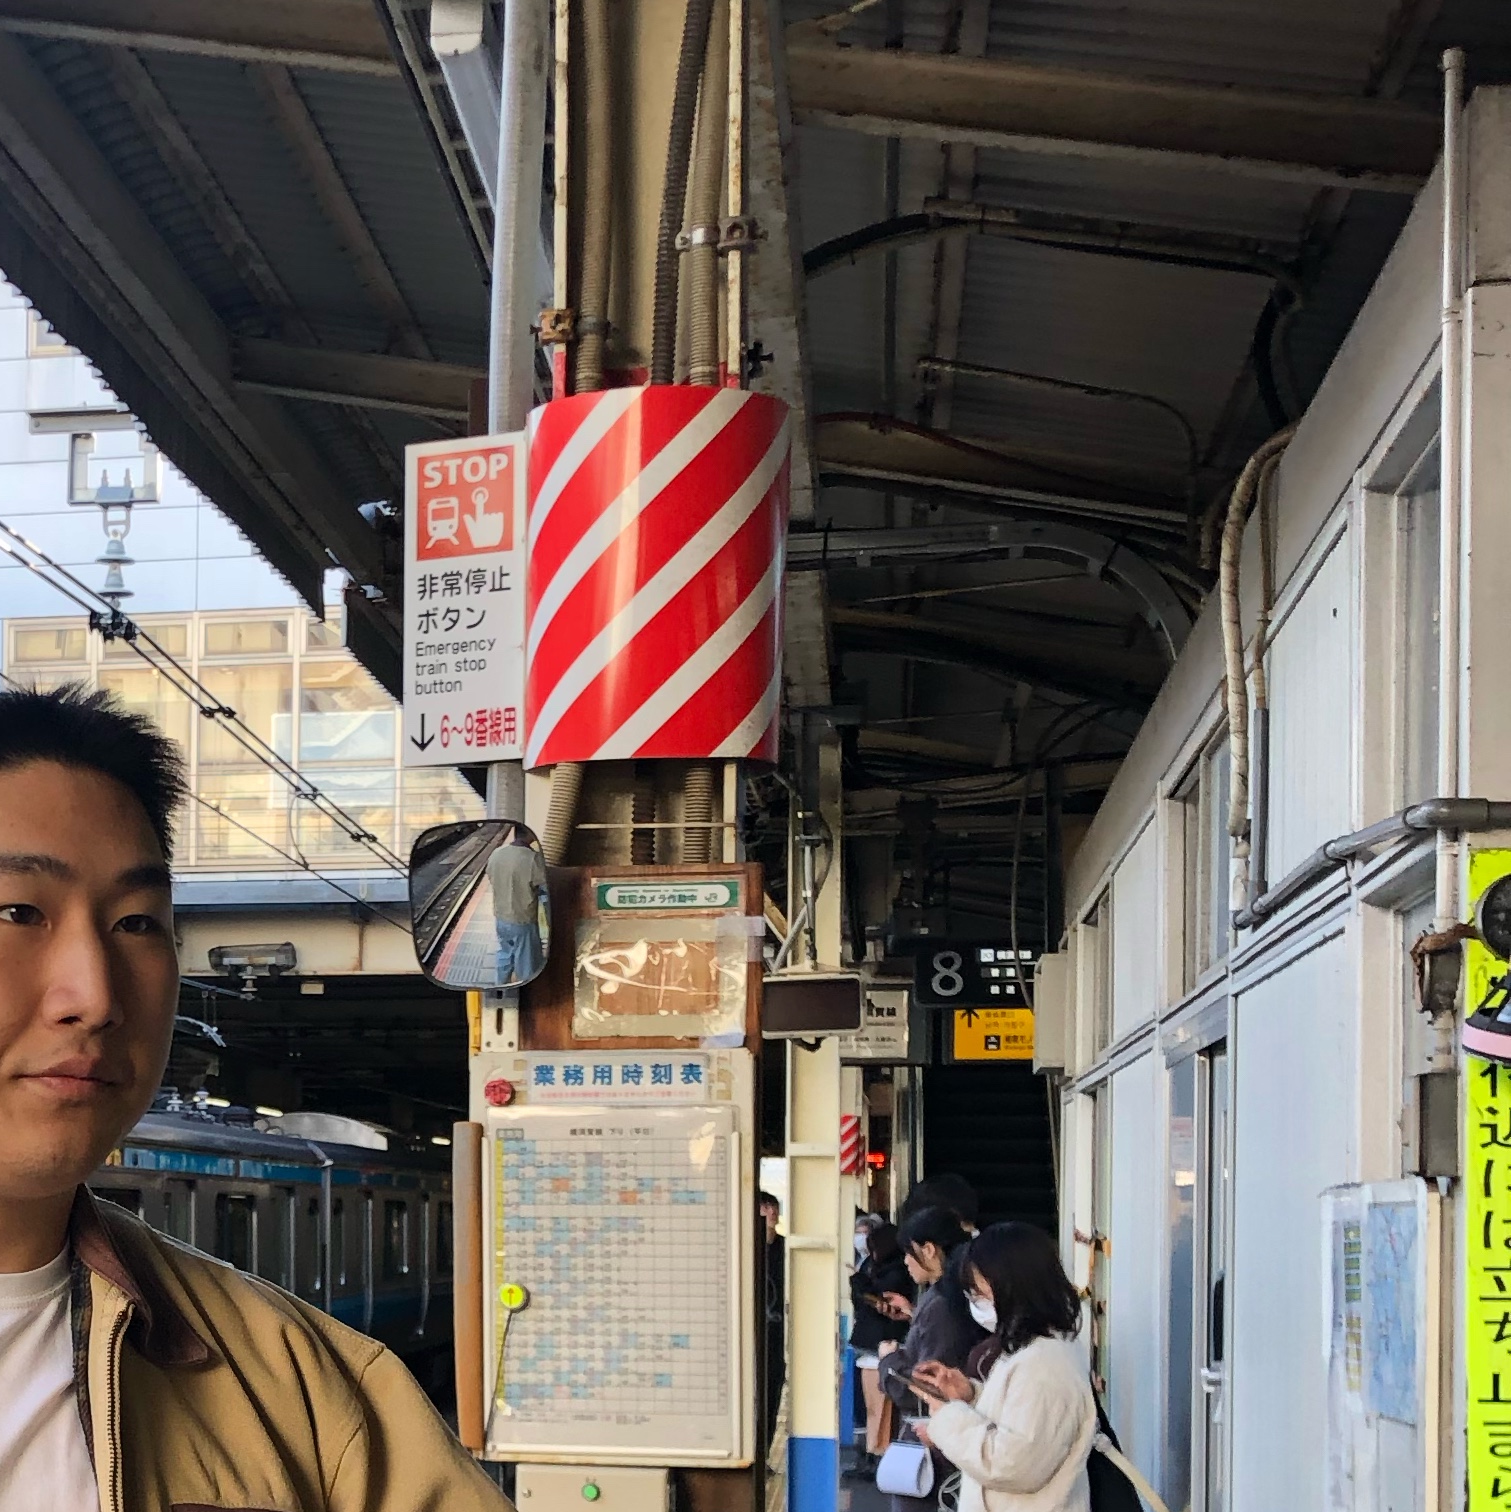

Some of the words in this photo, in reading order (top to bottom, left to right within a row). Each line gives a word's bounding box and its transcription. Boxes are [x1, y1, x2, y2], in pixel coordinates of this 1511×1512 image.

[423, 453, 509, 489] STOP
[417, 566, 511, 600] 非常停止
[417, 607, 486, 634] ボタン
[415, 637, 496, 657] Emergency
[415, 659, 447, 675] train
[454, 657, 487, 673] stop
[415, 678, 463, 696] button
[931, 951, 964, 997] 8
[534, 1063, 702, 1086] 業務用時刻表
